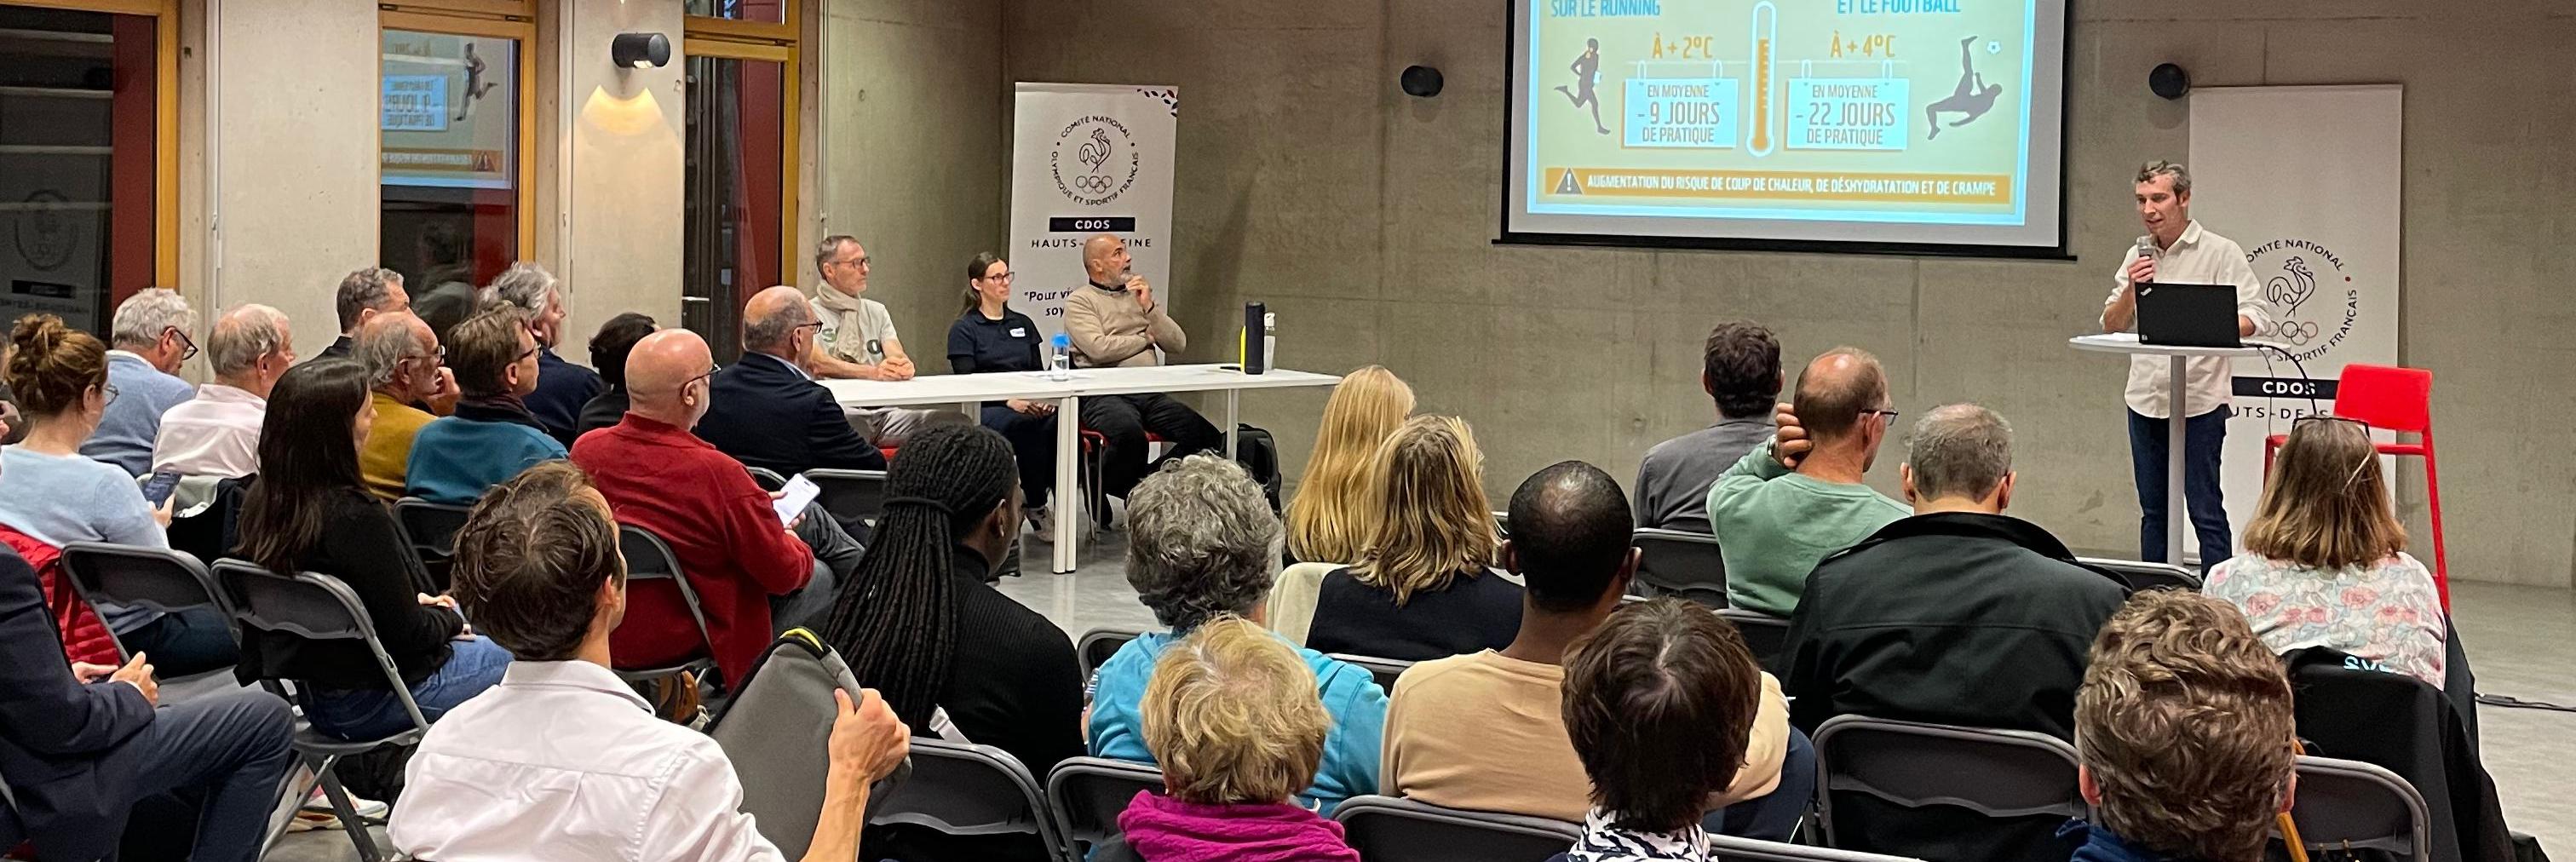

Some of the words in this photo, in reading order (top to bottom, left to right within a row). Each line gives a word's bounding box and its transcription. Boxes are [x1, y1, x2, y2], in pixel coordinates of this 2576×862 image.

[1550, 0, 1577, 17] SUR
[1581, 0, 1596, 17] LE
[1600, 0, 1660, 16] RUNNING
[1831, 30, 1842, 58] À
[1647, 85, 1659, 97] EN
[1662, 85, 1709, 97] MOYENNE
[1812, 85, 1825, 98] EN
[1827, 85, 1877, 98] MOYENNE
[1650, 101, 1659, 124] 9
[1665, 101, 1720, 124] JOURS
[1809, 102, 1831, 125] 22
[1837, 102, 1895, 126] JOURS
[1093, 115, 1130, 139] NATIONAL
[1642, 127, 1656, 142] DE
[1659, 127, 1714, 145] PRATIQUE
[1807, 129, 1821, 144] DE
[1825, 129, 1883, 146] PRATIQUE
[1051, 151, 1073, 198] OLYMPIQUE
[1074, 195, 1084, 204] ET
[1086, 192, 1118, 206] SPORTIF
[1588, 175, 1659, 189] AUGMENTATION
[1661, 176, 1674, 190] DU
[1676, 176, 1707, 191] RISQUE
[1711, 176, 1722, 190] DE
[1726, 177, 1751, 191] COUP
[1753, 177, 1766, 192] DE
[1768, 177, 1814, 193] CHALEUR,
[1816, 178, 1829, 193] DE
[1831, 176, 1918, 194] DÉSHYDRATATION
[1922, 181, 1934, 194] ET
[1937, 181, 1949, 195] DE
[1952, 181, 1996, 196] CRAMPE
[1074, 219, 1110, 230] CDOS
[2245, 239, 2282, 263] OMITÉ
[2286, 239, 2344, 272] NATIONAL
